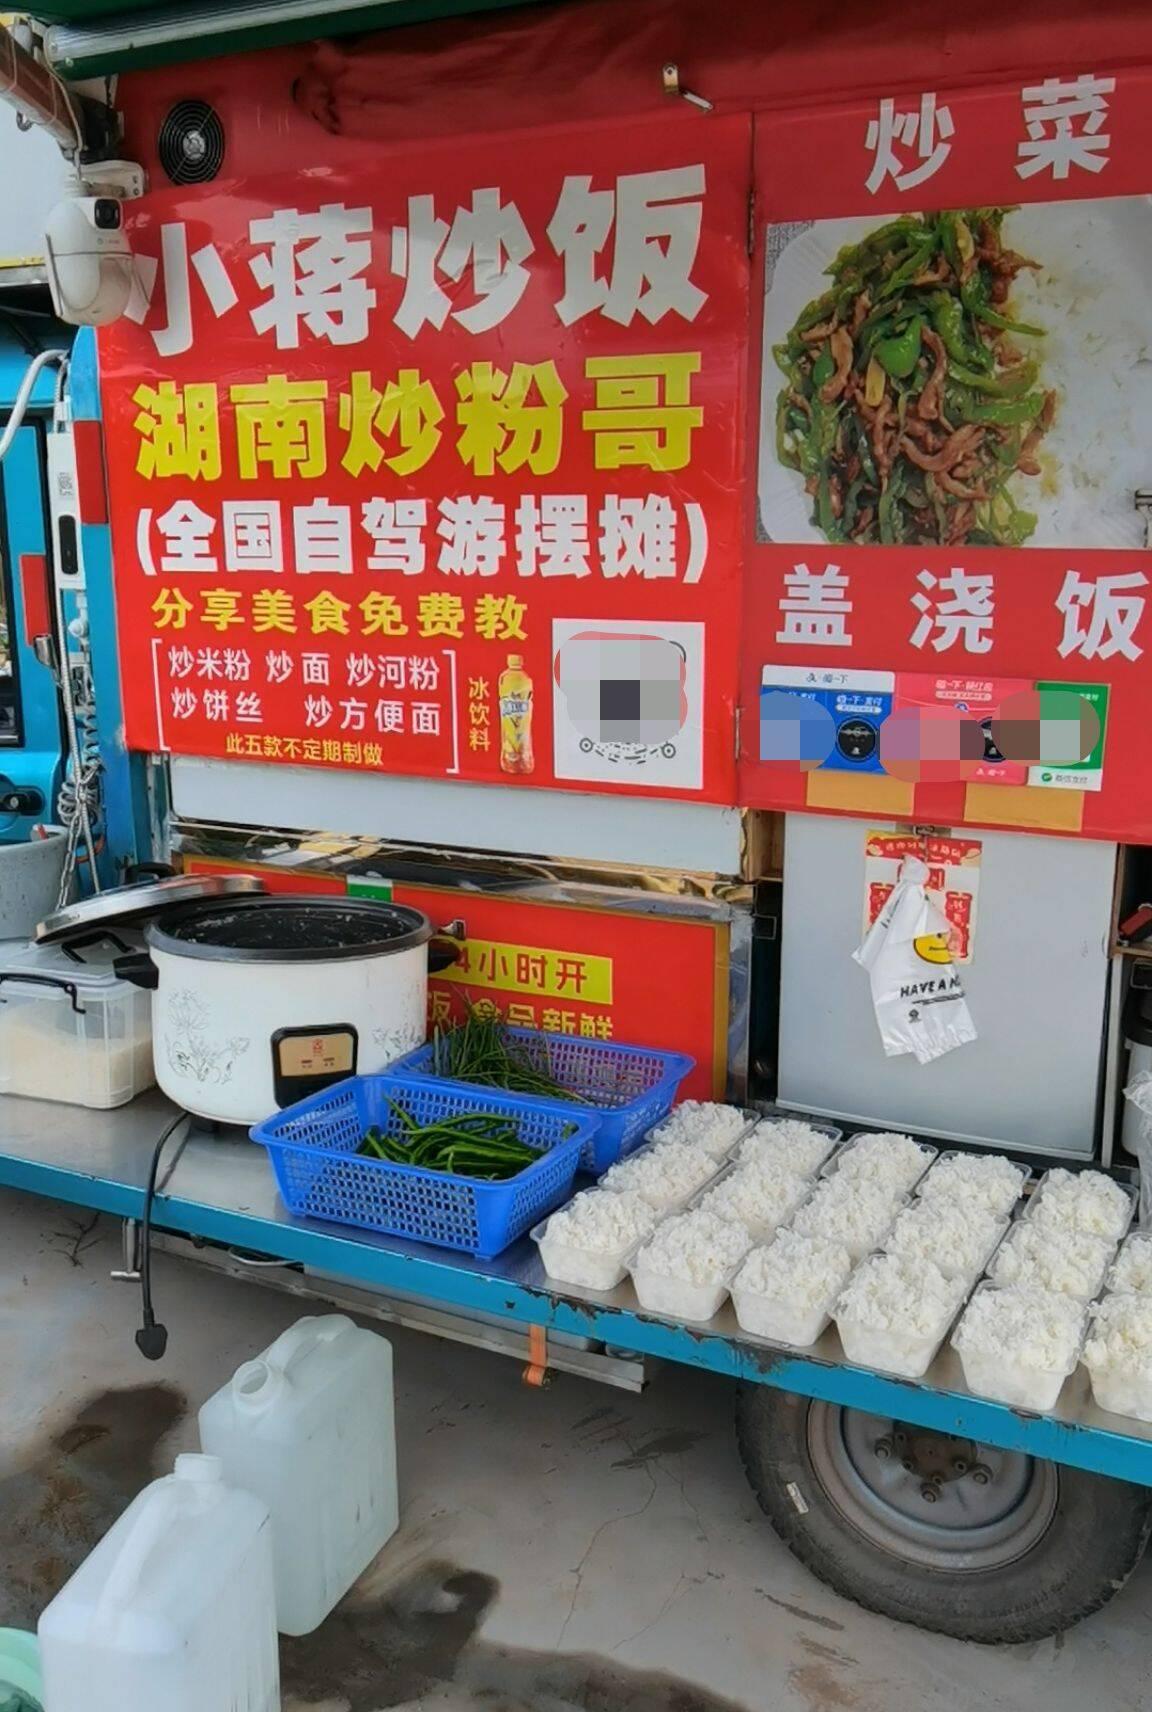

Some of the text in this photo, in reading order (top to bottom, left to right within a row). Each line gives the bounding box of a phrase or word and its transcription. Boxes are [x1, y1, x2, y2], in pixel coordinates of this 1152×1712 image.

[864, 74, 1116, 195] 炒菜
[123, 164, 709, 357] 小蒋炒饭
[132, 352, 704, 482] 湖南炒粉哥
[136, 494, 708, 583] (全国自驾游摆摊)
[152, 588, 528, 641] 分享美食免费教
[775, 563, 1150, 662] 盖浇饭
[168, 647, 251, 682] 炒米粉
[346, 653, 441, 692] 炒河粉
[171, 689, 441, 737] 炒饼丝 炒方便面
[226, 734, 383, 767] 此五款不定期制做
[467, 676, 490, 752] 冰饮料
[900, 981, 935, 998] HAVE
[938, 979, 946, 991] A
